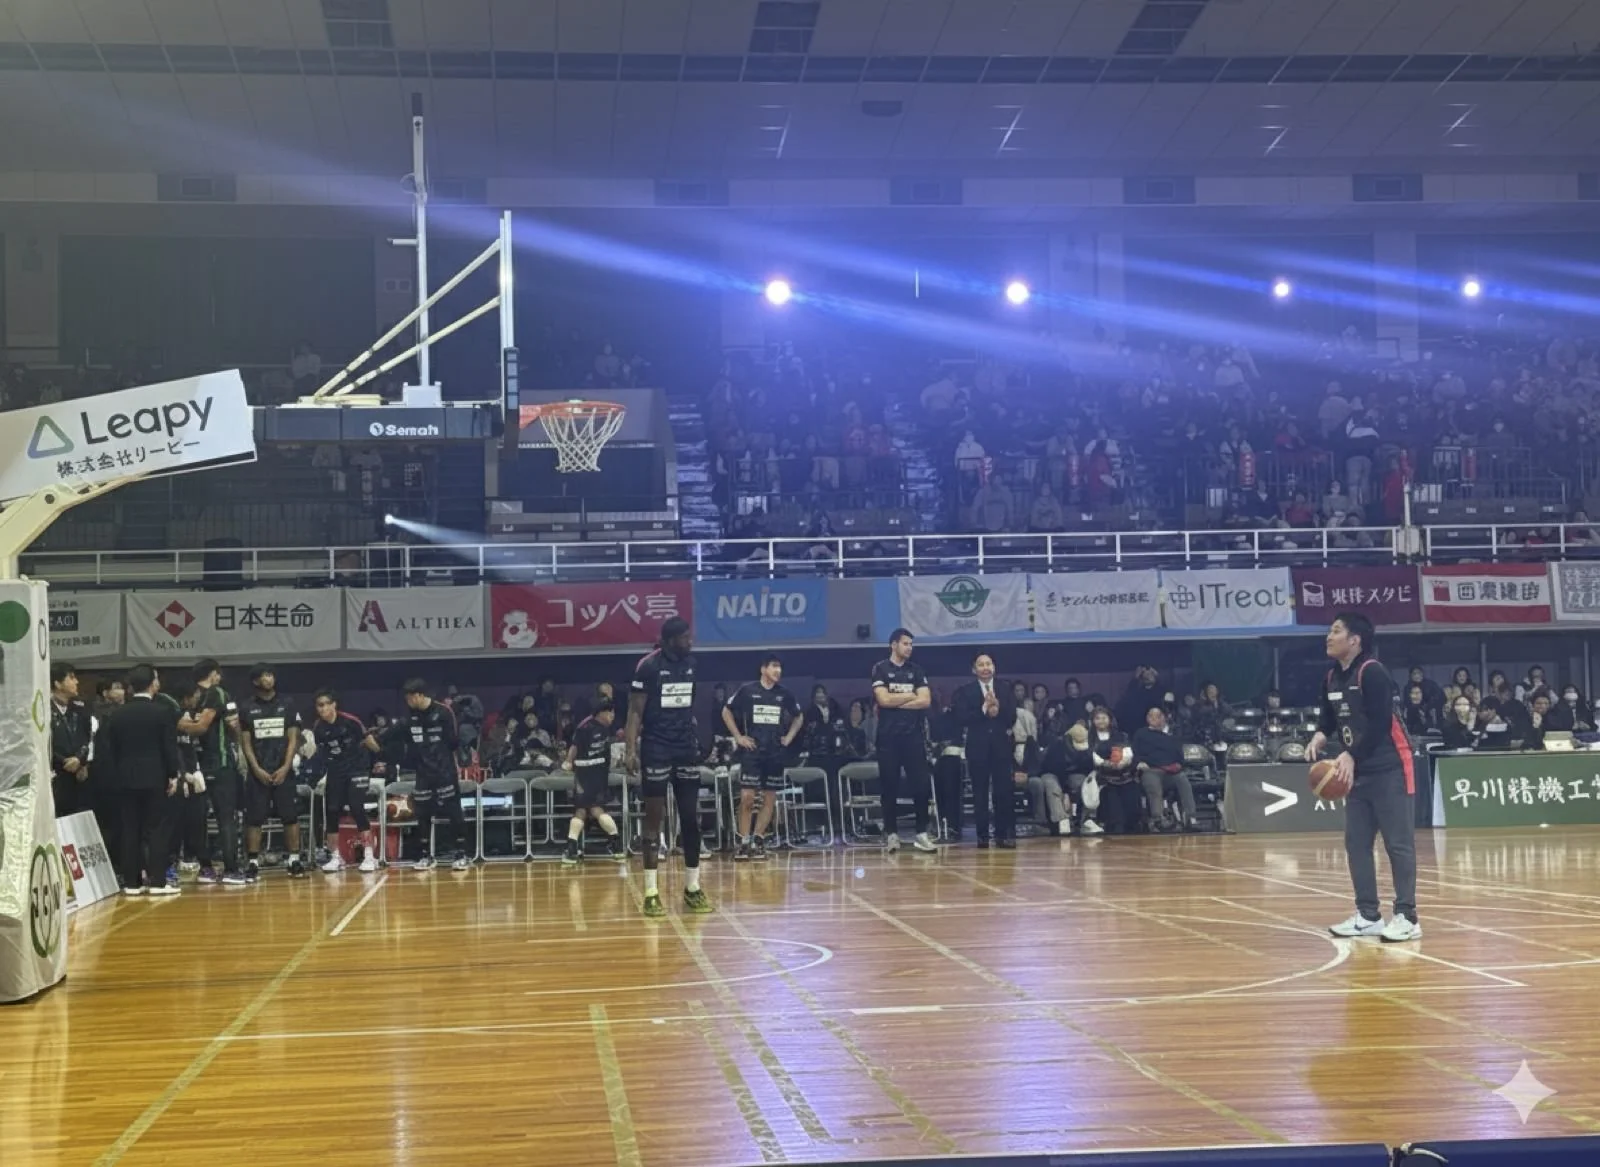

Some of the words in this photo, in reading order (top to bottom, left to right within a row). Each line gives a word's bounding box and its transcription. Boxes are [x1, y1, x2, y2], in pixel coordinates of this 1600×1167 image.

[80, 396, 214, 445] Leapy
[716, 588, 808, 620] NAITO
[1199, 582, 1287, 609] ITreat
[214, 603, 315, 631] 日本生命
[395, 616, 477, 630] ALTHEA
